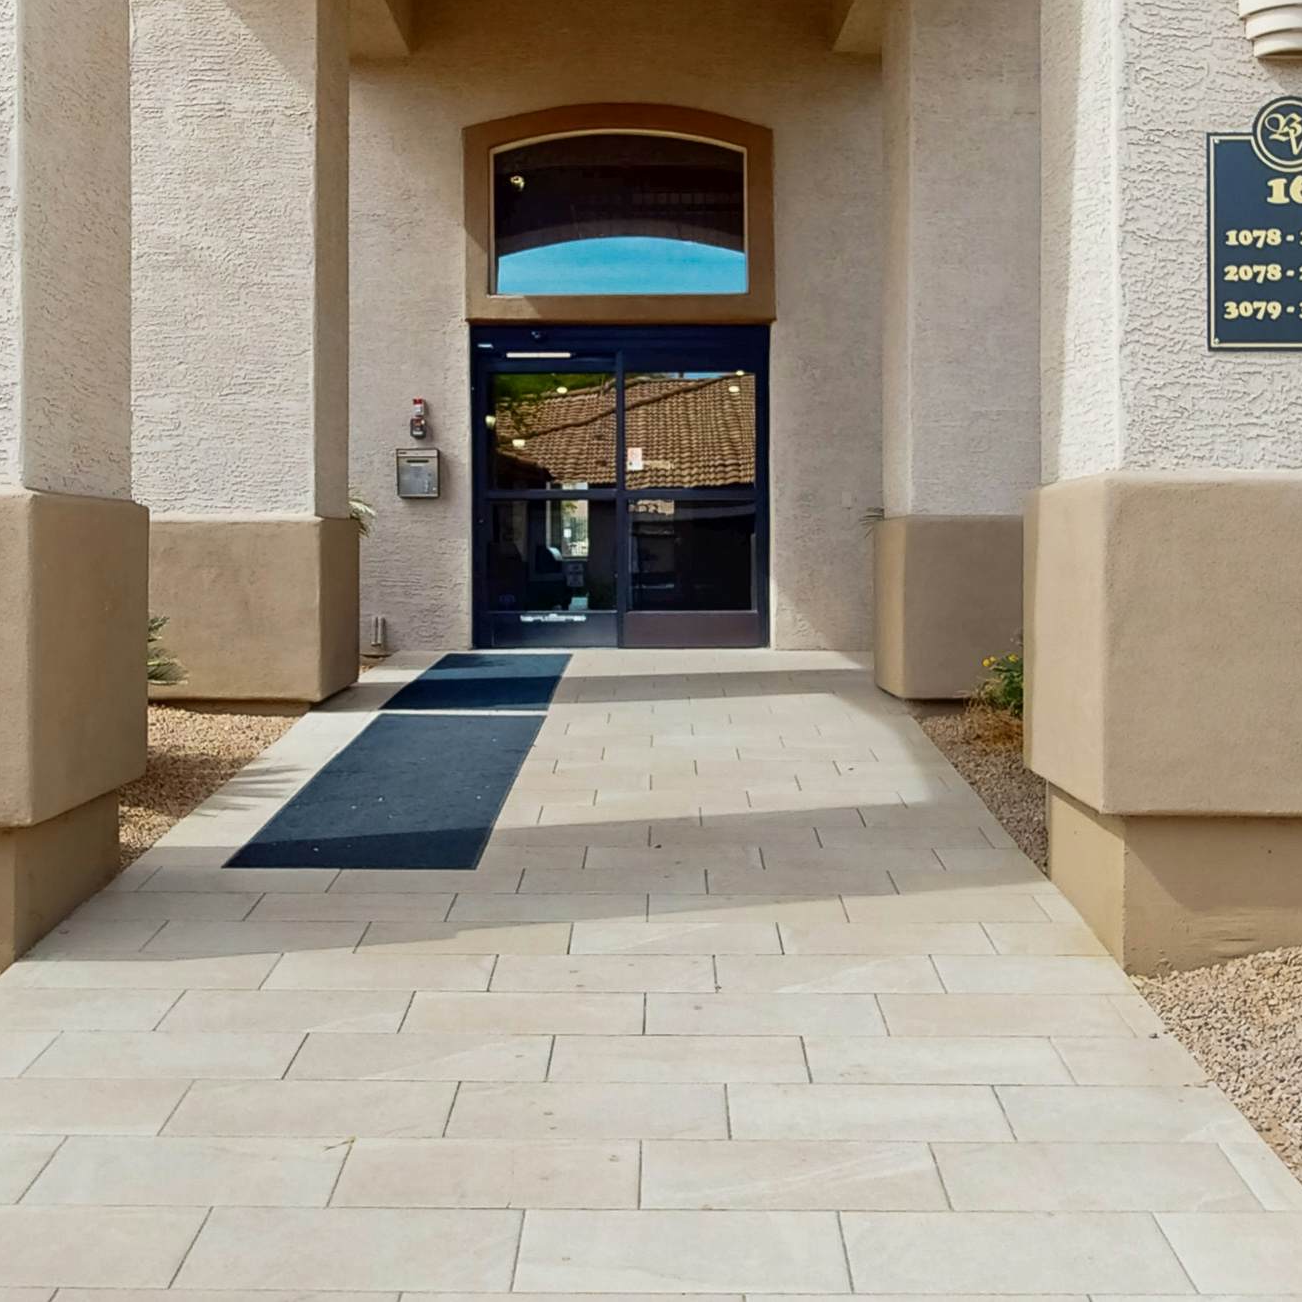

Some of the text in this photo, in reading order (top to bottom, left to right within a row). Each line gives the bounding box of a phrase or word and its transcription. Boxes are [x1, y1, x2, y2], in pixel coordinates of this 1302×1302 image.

[1225, 228, 1282, 248] 1078
[1223, 263, 1282, 283] 2078
[1223, 300, 1282, 320] 3079
